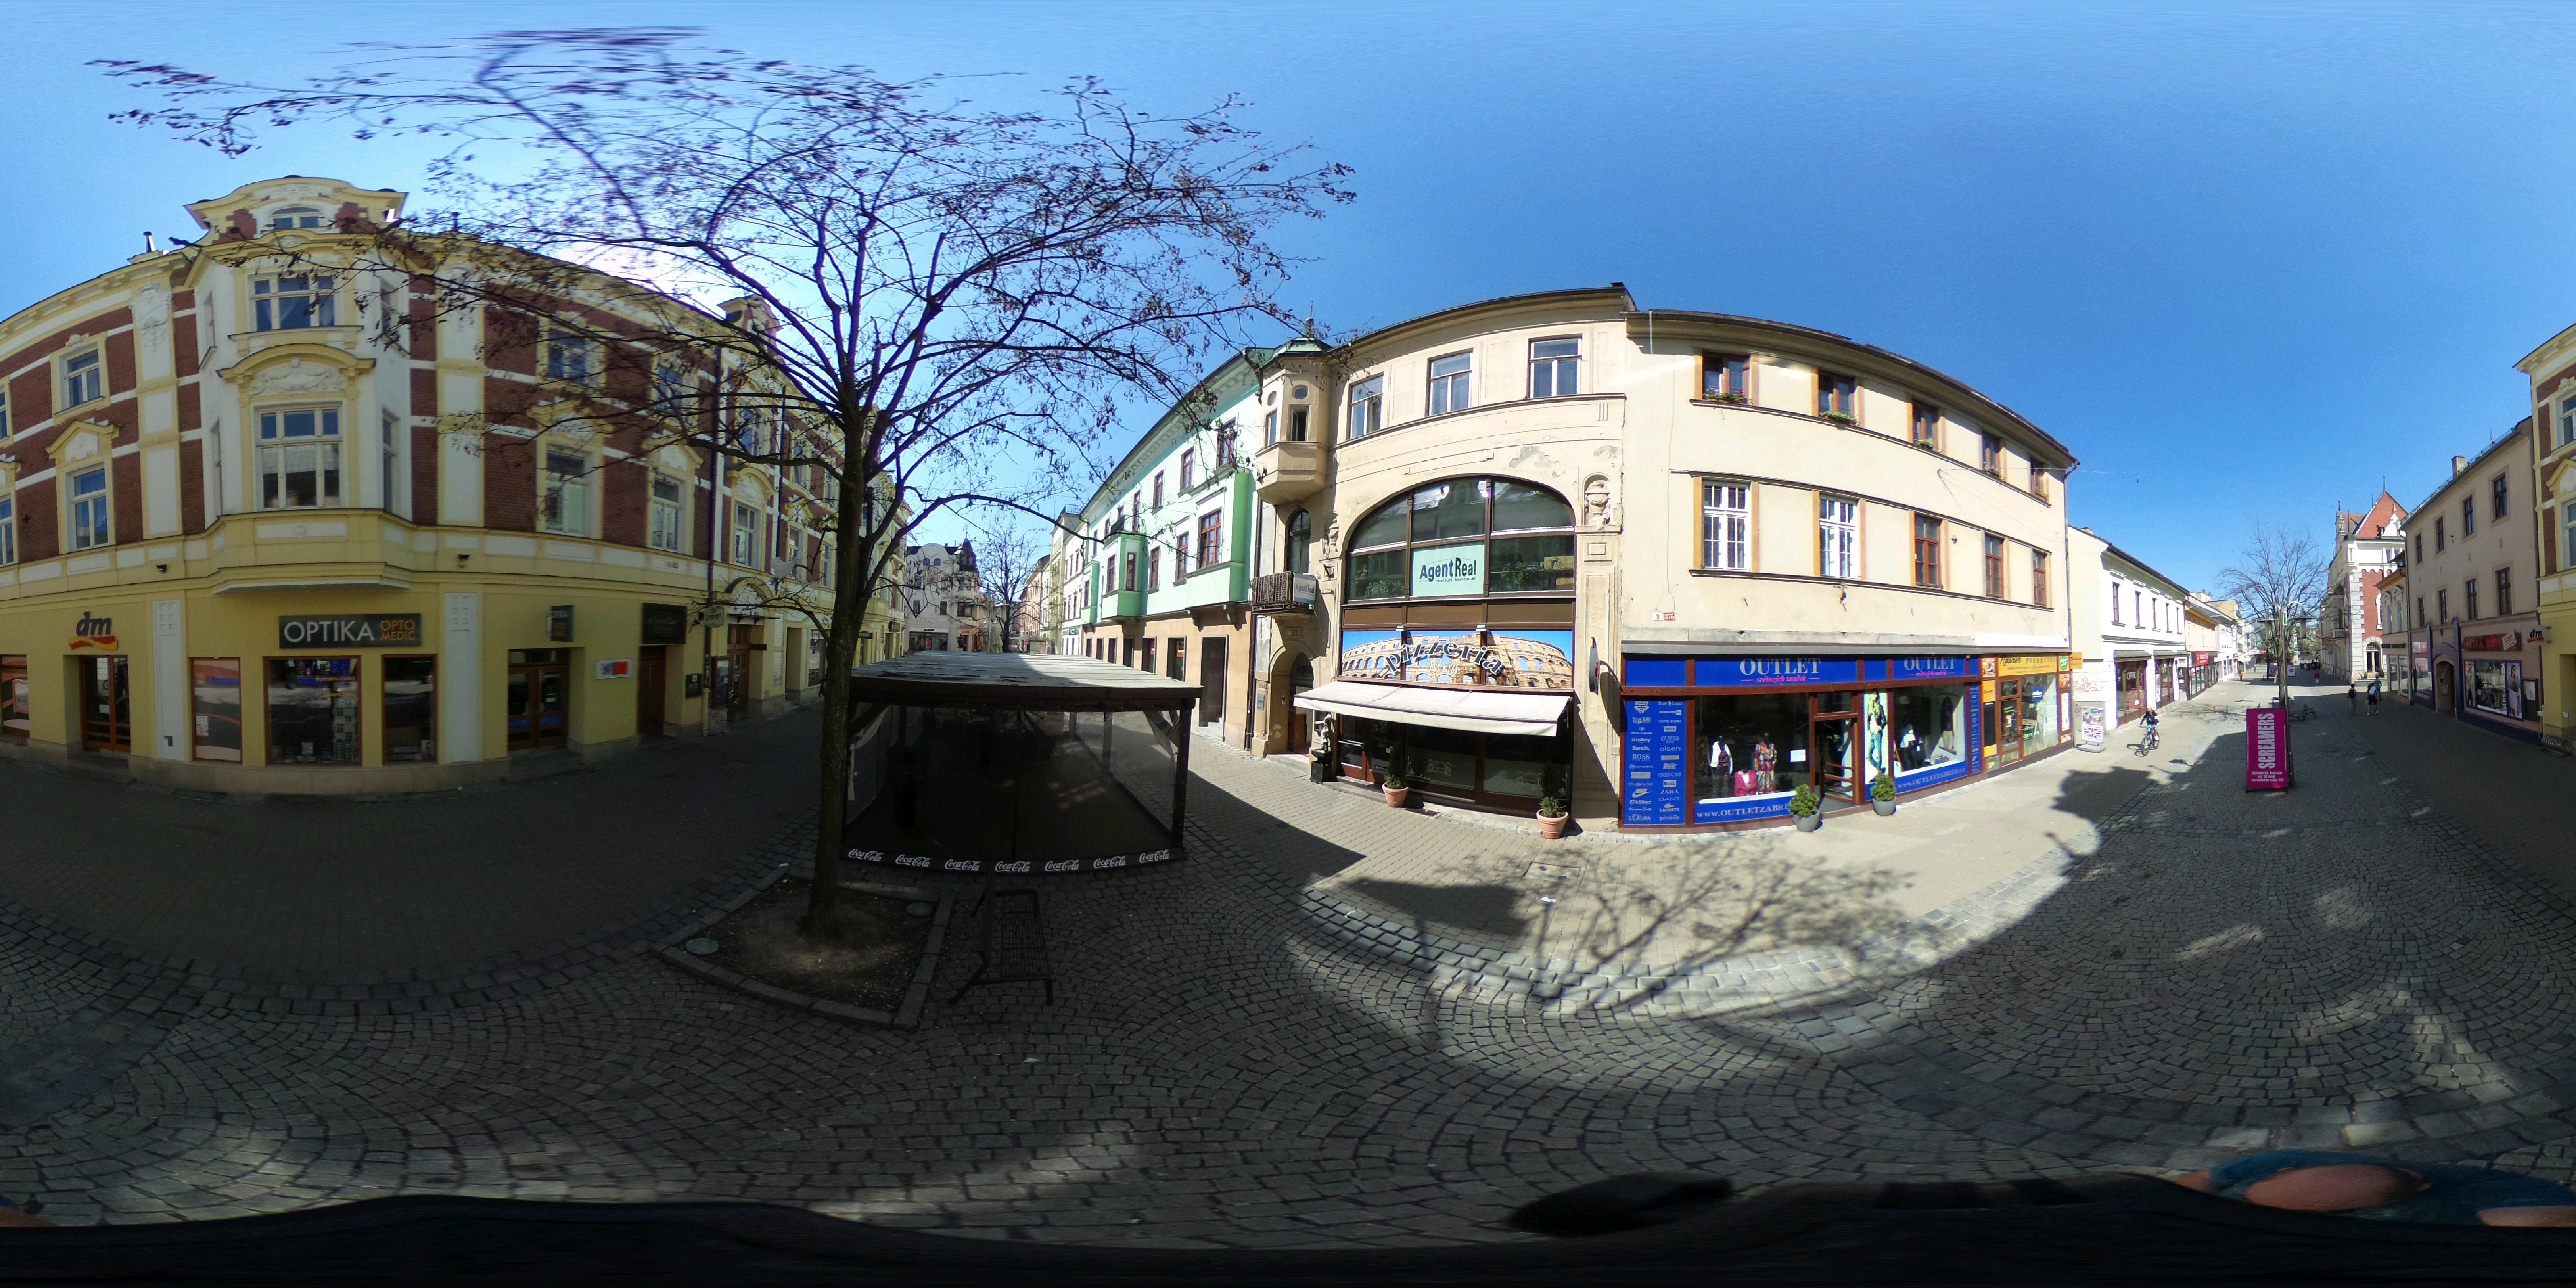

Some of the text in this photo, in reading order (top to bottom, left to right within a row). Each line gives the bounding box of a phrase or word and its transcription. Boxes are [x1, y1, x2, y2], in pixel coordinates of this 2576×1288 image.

[76, 612, 112, 636] dm
[284, 620, 375, 642] OPTIKA
[380, 619, 416, 631] OPTO
[381, 631, 415, 641] MEDIC
[2530, 629, 2542, 637] dm
[1385, 642, 1503, 675] pizzeria
[1426, 658, 1458, 674] Istria
[1740, 658, 1821, 675] OUTLET
[1904, 657, 1956, 670] OUTLET
[2257, 713, 2276, 769] SCREAMERS
